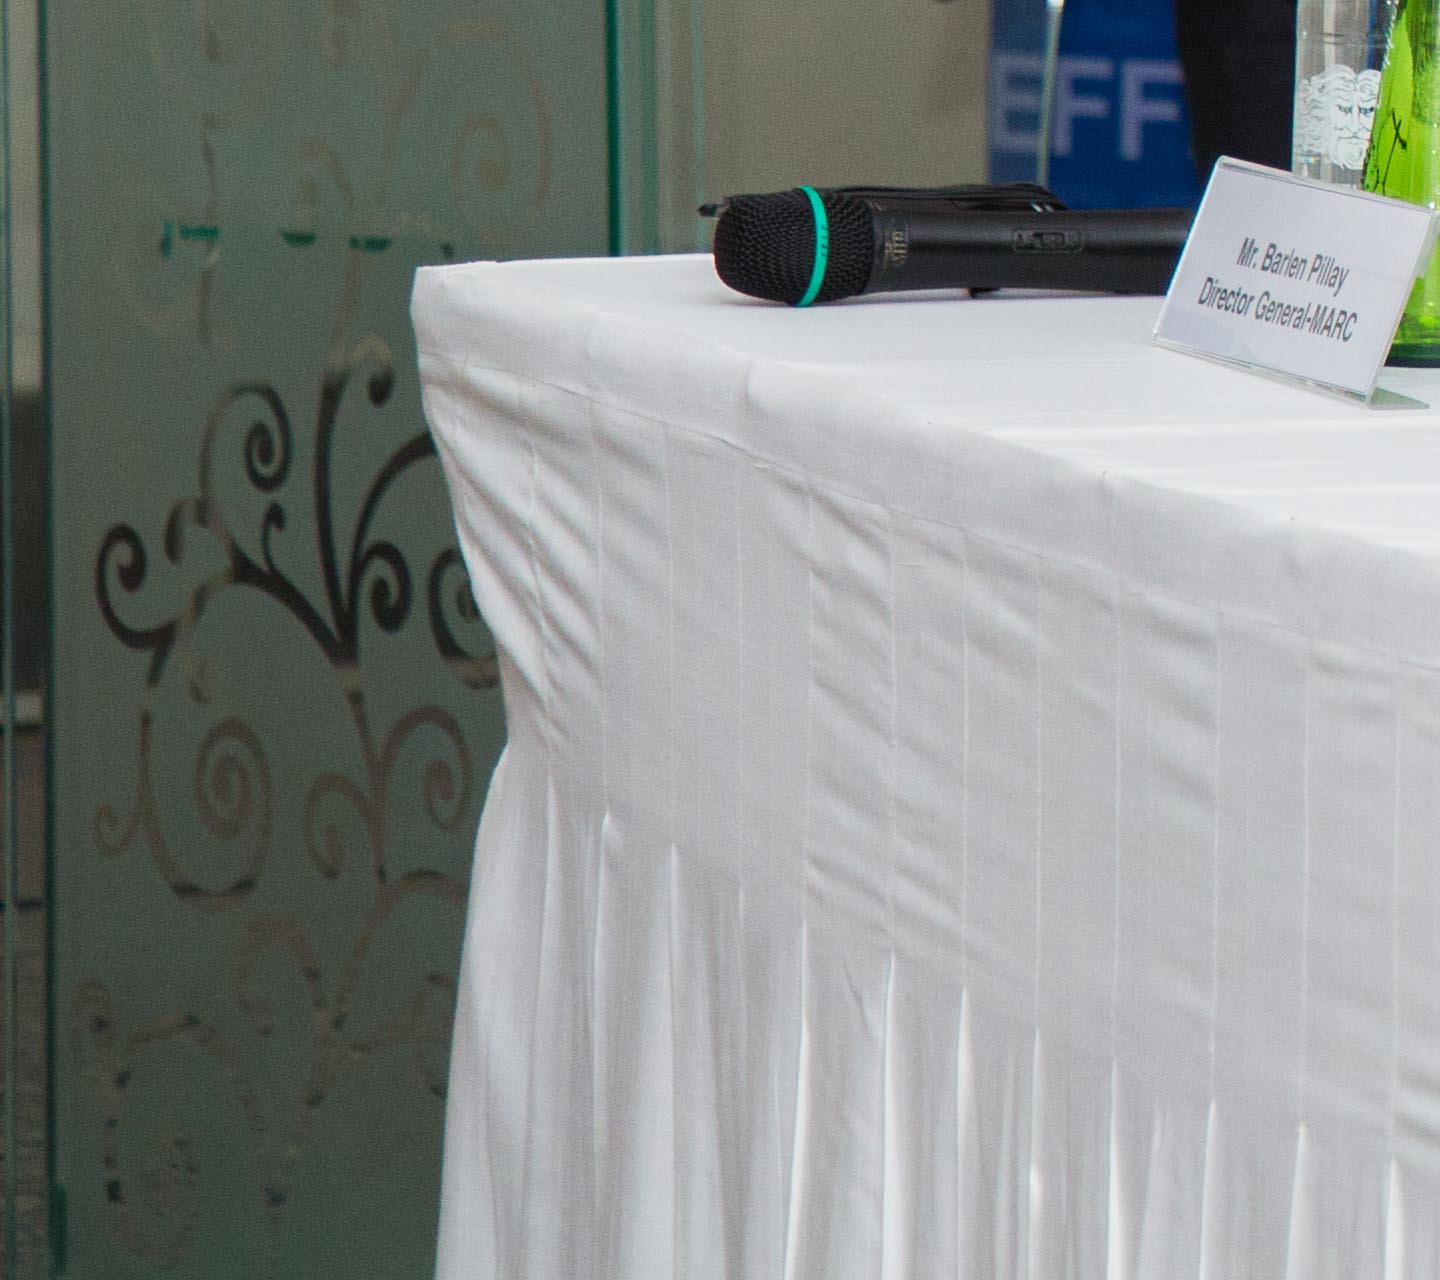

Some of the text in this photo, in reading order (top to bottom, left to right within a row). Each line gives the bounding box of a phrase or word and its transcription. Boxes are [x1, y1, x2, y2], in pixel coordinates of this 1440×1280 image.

[995, 57, 1185, 160] EFF
[1236, 238, 1350, 296] Mr. Barlen Pillay
[1198, 277, 1358, 342] Director General-MARC
